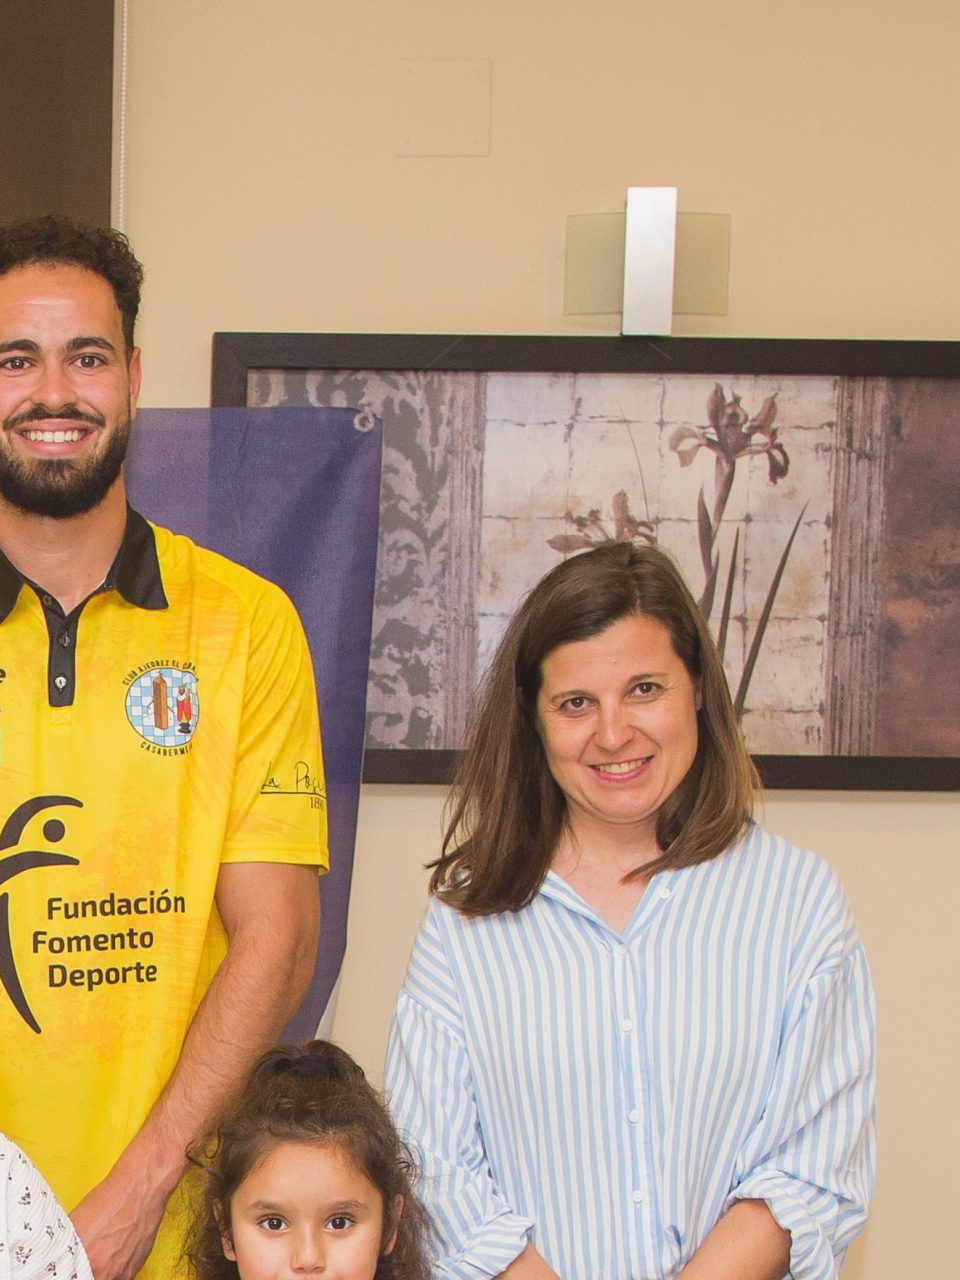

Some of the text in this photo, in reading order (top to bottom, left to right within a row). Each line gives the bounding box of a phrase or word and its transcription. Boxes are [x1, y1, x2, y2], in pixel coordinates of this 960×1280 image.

[121, 669, 138, 686] CLUB
[47, 888, 186, 920] Fundación
[32, 928, 154, 954] Fomento
[48, 961, 158, 991] Deporte
